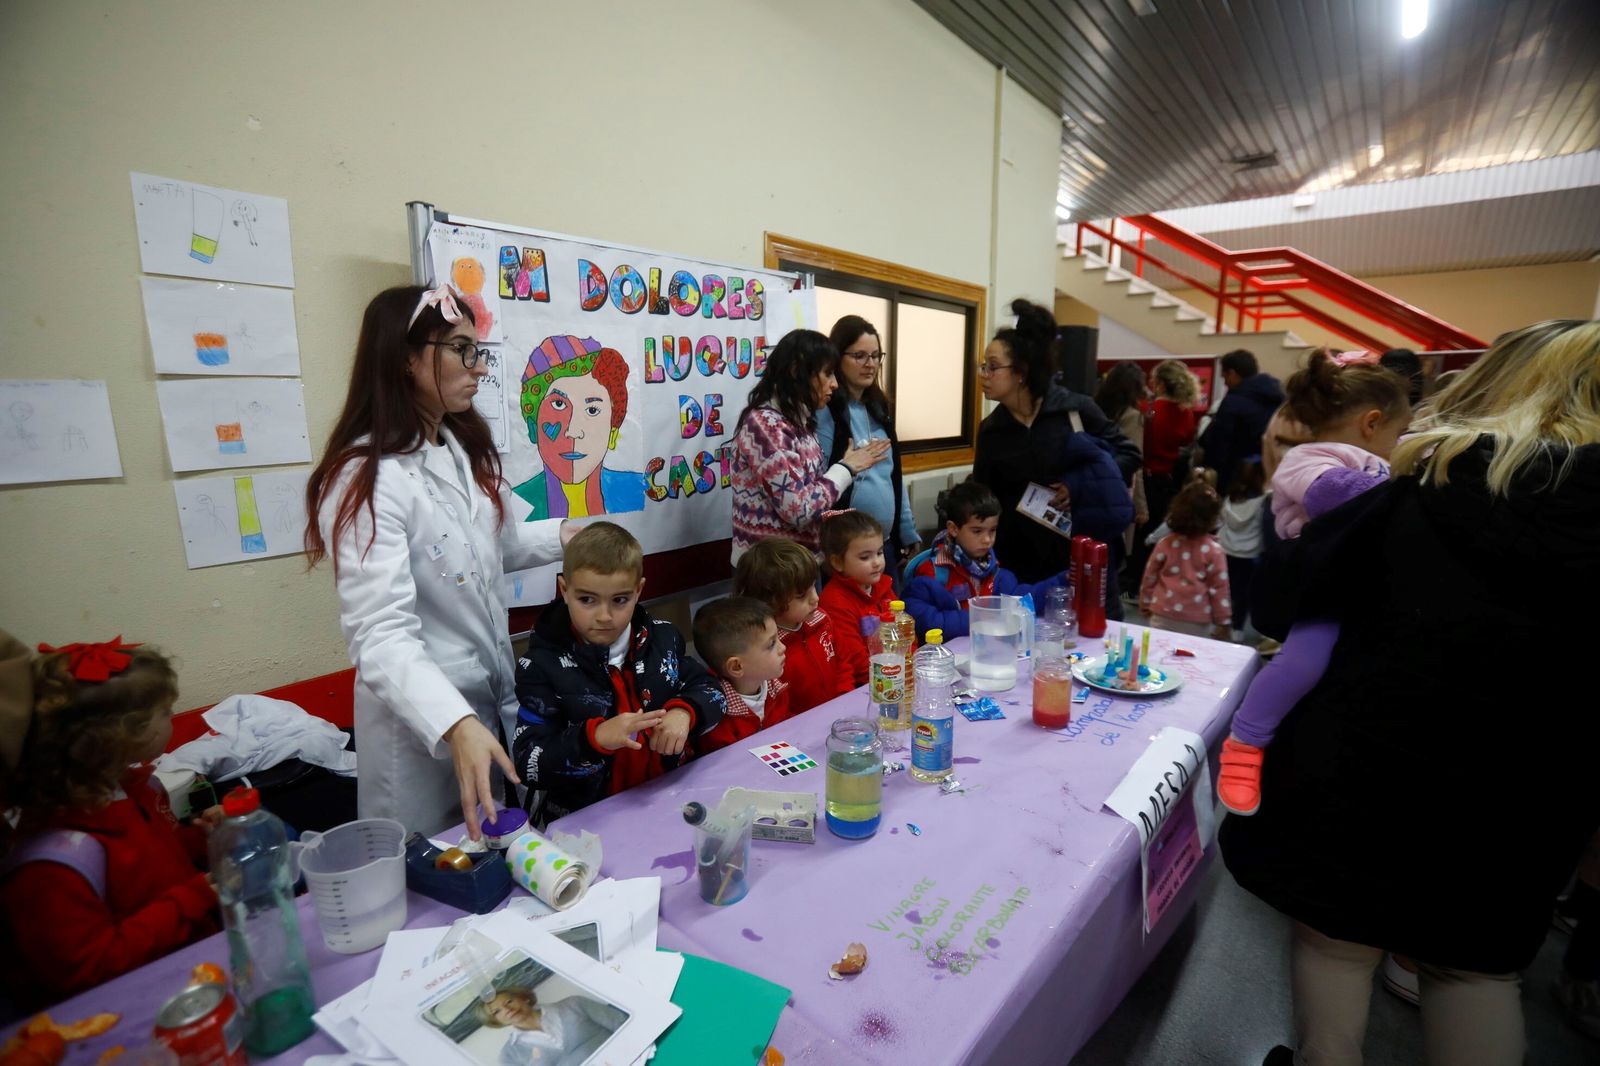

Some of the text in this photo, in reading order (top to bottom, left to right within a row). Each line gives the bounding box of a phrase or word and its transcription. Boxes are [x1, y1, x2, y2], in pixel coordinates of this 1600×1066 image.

[577, 258, 764, 320] DOLORES
[644, 335, 768, 384] LUQUE
[679, 393, 724, 439] DE
[644, 447, 732, 502] CAST
[866, 876, 937, 932] VINAGRE
[926, 883, 997, 962] COLORANTE
